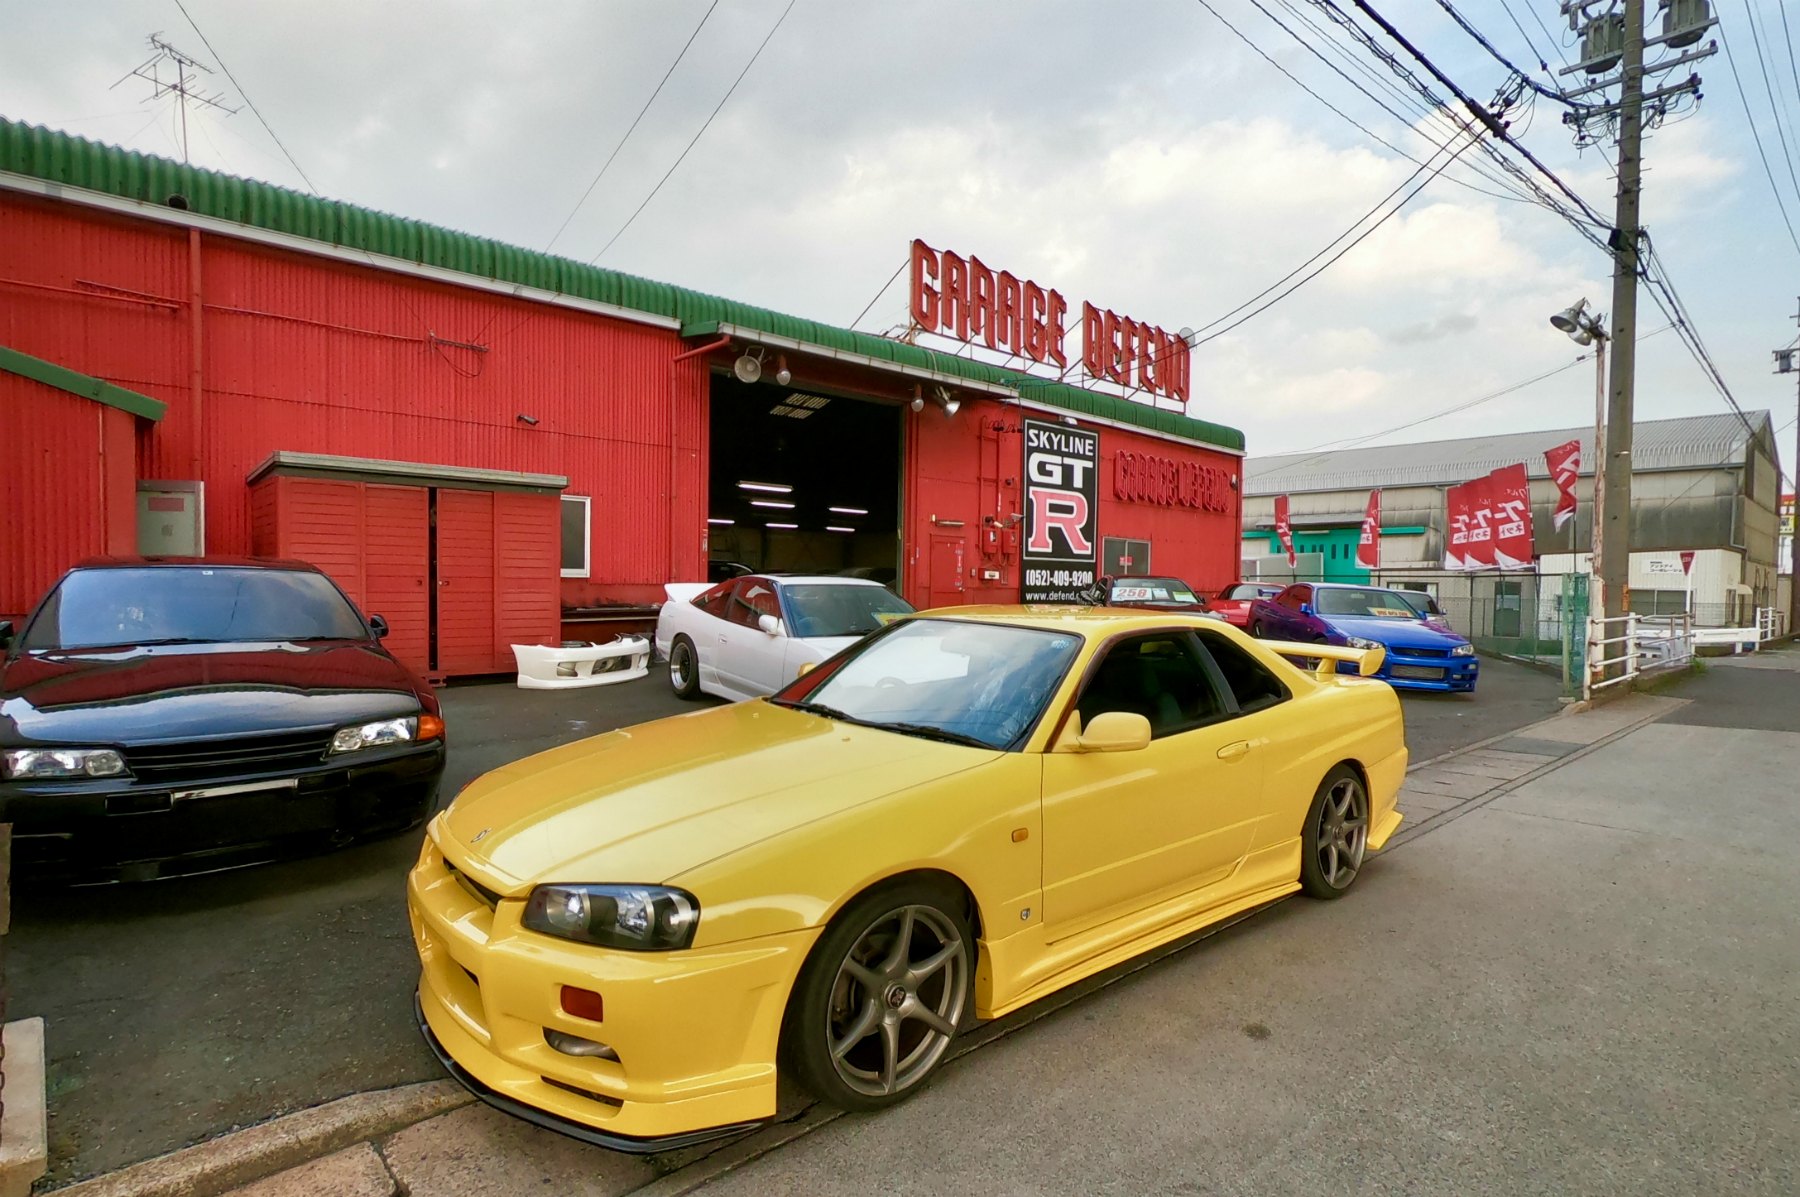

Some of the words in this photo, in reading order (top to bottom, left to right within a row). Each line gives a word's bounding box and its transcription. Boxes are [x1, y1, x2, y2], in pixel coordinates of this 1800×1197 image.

[910, 238, 1067, 369] GARAGE
[1083, 300, 1190, 403] DEFEND
[1028, 429, 1094, 456] SKYLINE
[1028, 452, 1094, 488] GT
[1114, 450, 1176, 507] GARAGE
[1178, 461, 1229, 513] DEFEND
[1028, 486, 1092, 554] R
[1025, 591, 1080, 601] www.defend.c
